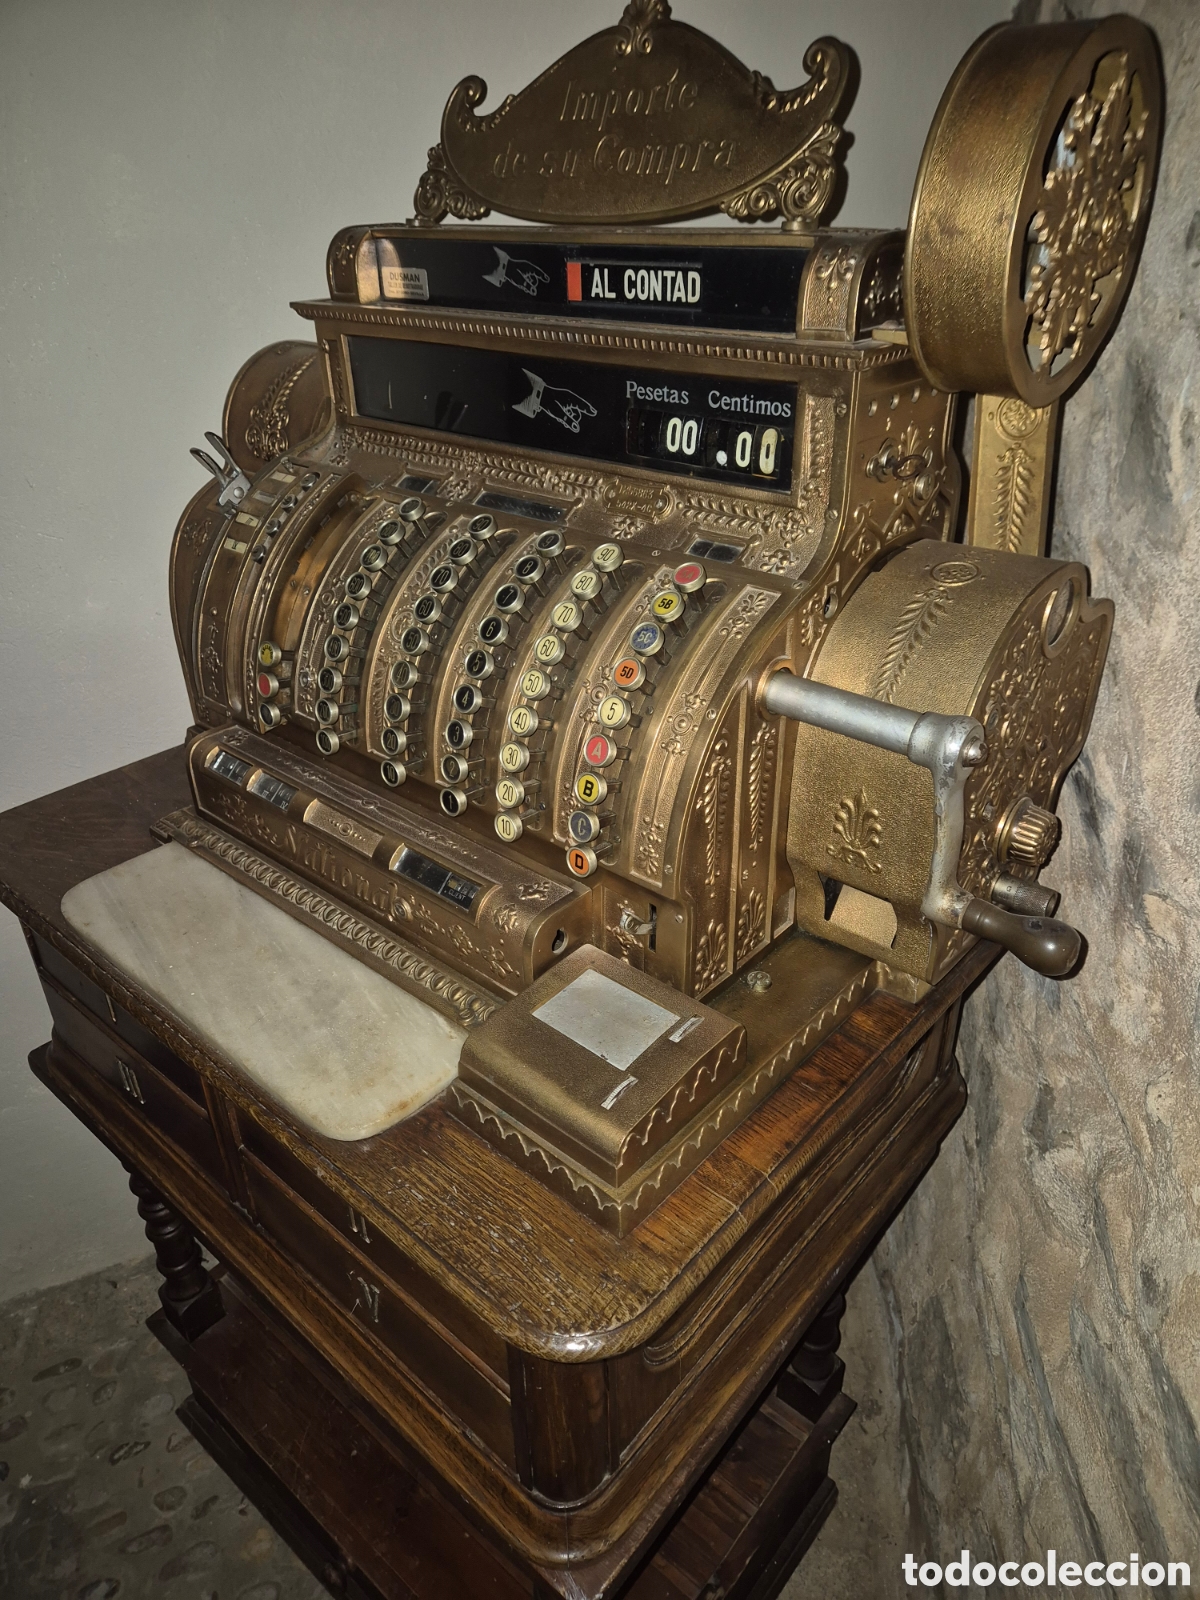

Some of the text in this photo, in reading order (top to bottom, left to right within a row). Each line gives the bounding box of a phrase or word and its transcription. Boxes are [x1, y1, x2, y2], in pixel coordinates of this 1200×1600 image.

[559, 67, 699, 131] Importe
[492, 133, 738, 185] de su Compra
[390, 271, 420, 282] DUSMAN
[591, 268, 616, 298] AL
[626, 380, 792, 417] Pesetas Centimos
[597, 548, 616, 562] 90
[522, 561, 534, 574] 8
[437, 570, 450, 585] 70
[575, 576, 592, 590] 80
[418, 600, 431, 616] 60
[657, 598, 673, 610] 5B
[558, 605, 574, 622] 70
[486, 621, 497, 636] 6
[637, 631, 653, 644] 5C
[540, 639, 556, 657] 60
[472, 654, 482, 672] 5
[620, 665, 634, 679] 5D
[526, 676, 540, 693] 50
[462, 690, 471, 707] 4
[607, 702, 618, 721] 5
[514, 713, 528, 731] 40
[386, 734, 396, 750] 20
[453, 726, 460, 742] 3
[505, 747, 519, 762] 30
[591, 742, 602, 759] A
[386, 765, 395, 781] 10
[449, 761, 456, 777] 2
[502, 783, 514, 798] 20
[583, 780, 594, 797] B
[501, 820, 511, 836] 10
[577, 817, 587, 837] C
[575, 854, 584, 869] D
